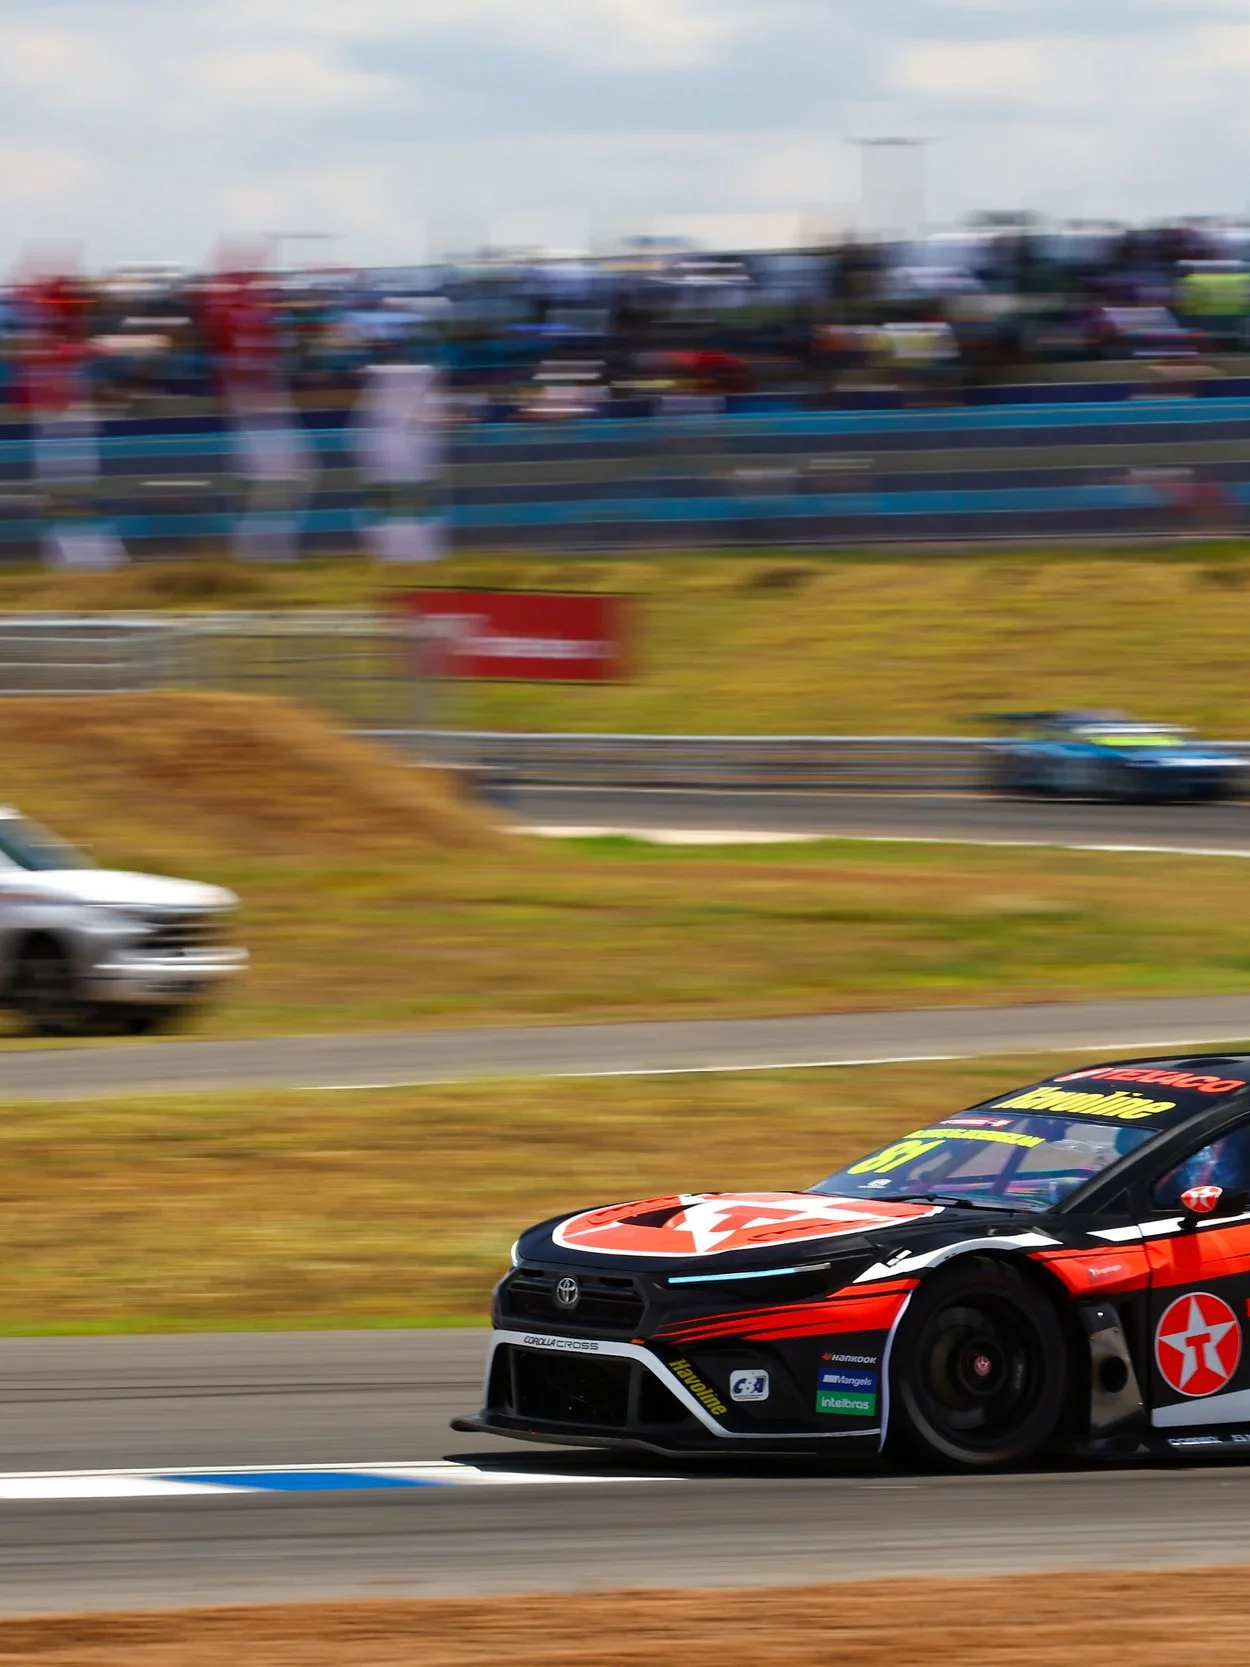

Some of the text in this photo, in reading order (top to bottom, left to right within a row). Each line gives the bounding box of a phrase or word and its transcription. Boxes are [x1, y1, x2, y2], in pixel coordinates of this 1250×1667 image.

[1091, 1068, 1247, 1093] TEXACO
[991, 1087, 1177, 1119] Havoline
[847, 1140, 946, 1175] 81
[668, 1359, 727, 1415] Havoline
